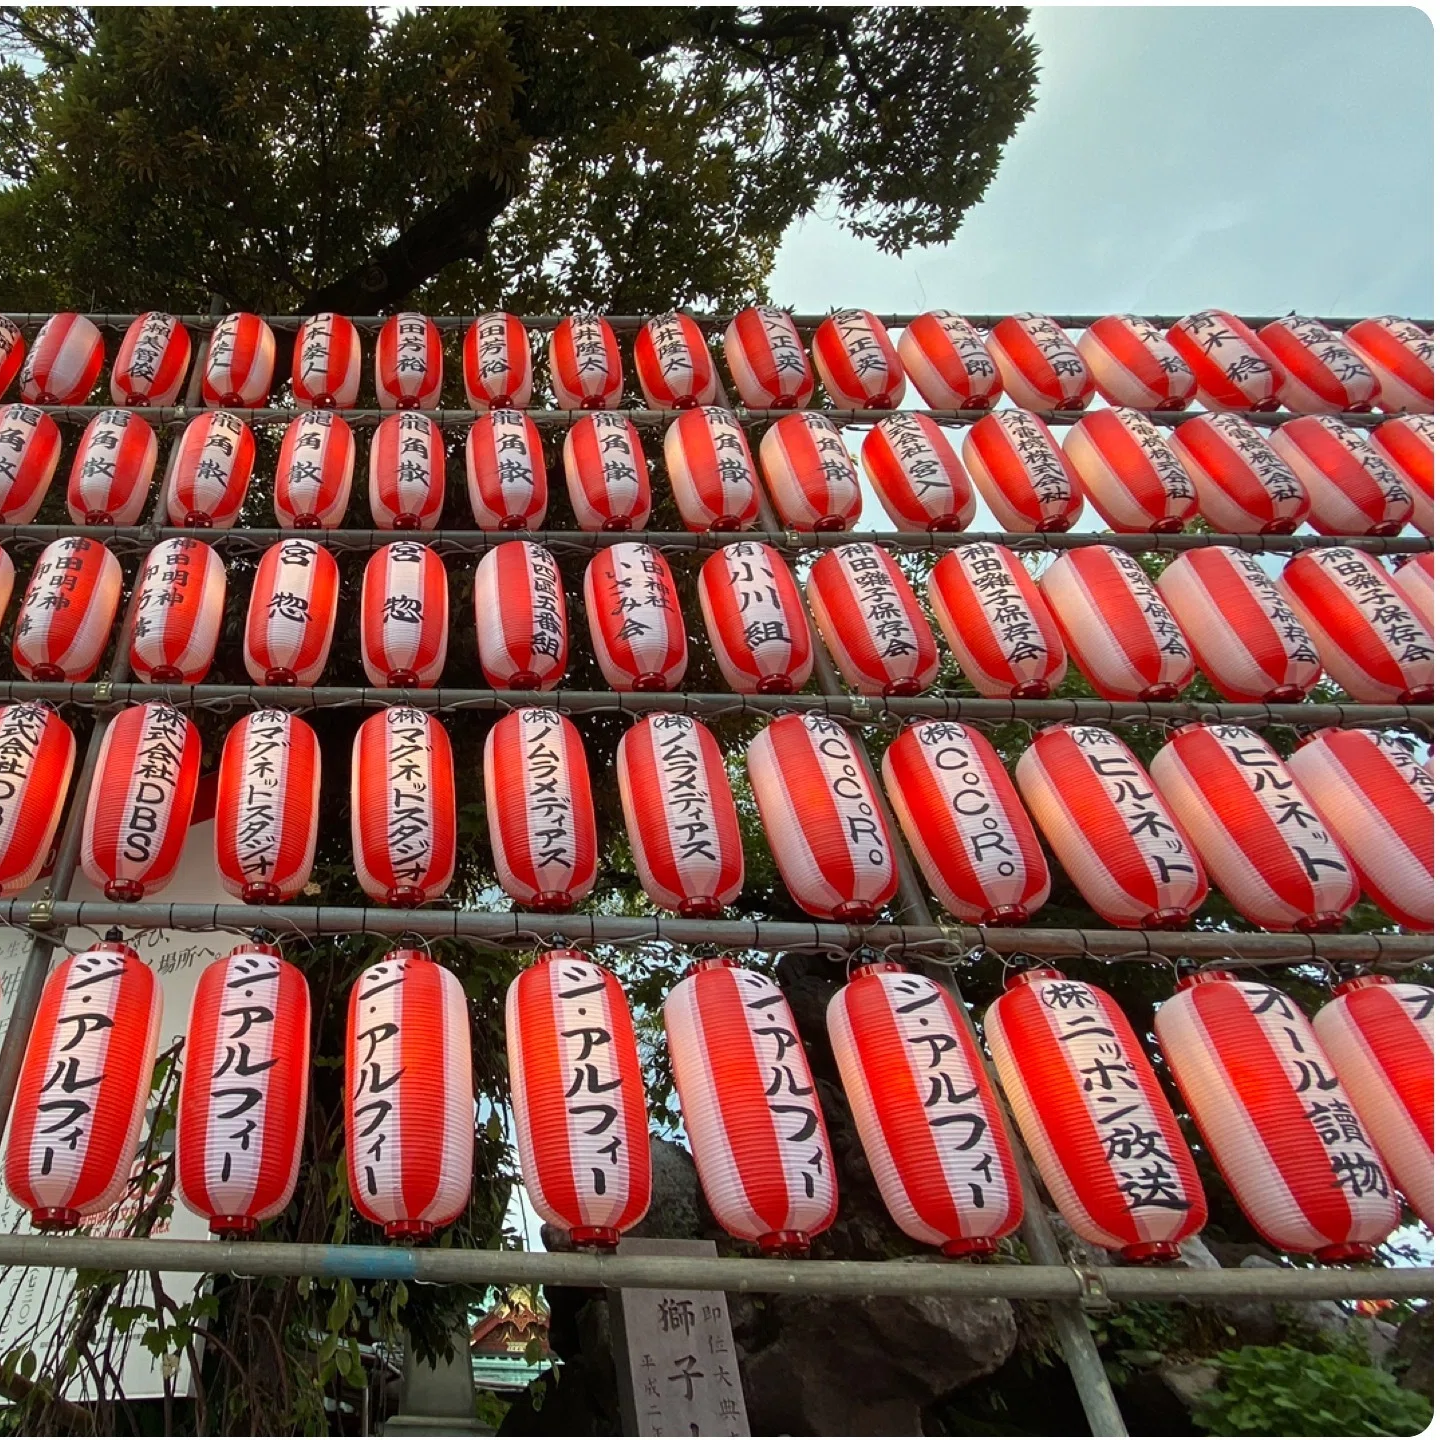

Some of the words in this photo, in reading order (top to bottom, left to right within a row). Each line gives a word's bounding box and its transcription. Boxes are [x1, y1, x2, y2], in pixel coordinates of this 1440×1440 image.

[38, 537, 92, 612] 神田明神
[155, 537, 198, 607] 神田明神
[959, 543, 1048, 663] 神田囃子保存会
[38, 956, 129, 1177] ジ・アルフィー
[210, 957, 282, 1183] ジ・アルフィー
[557, 965, 624, 1196] ジ・アルフィー
[657, 1298, 705, 1436] 獅子
[702, 1305, 740, 1436] 即位大典
